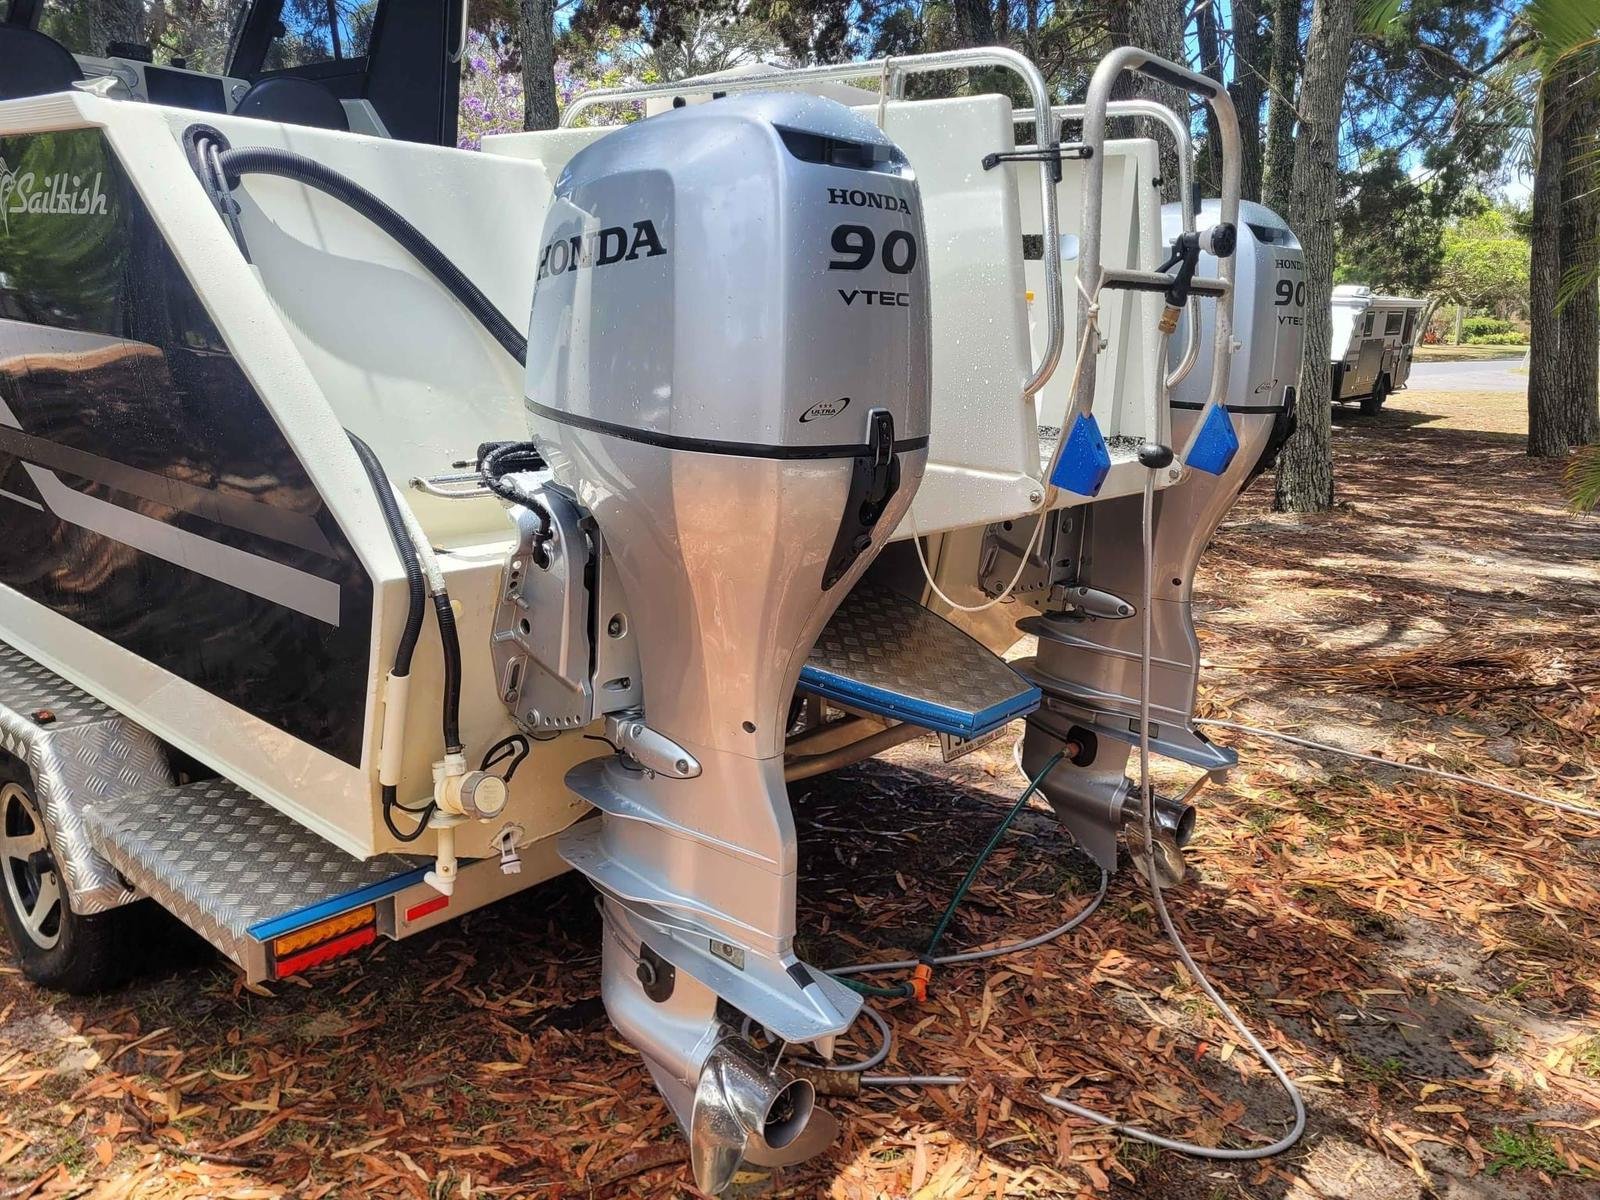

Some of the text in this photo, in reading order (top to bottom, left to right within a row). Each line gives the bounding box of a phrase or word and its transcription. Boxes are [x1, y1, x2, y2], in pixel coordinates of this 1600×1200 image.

[9, 172, 107, 214] Sailfish
[827, 187, 912, 216] HONDA
[537, 219, 667, 281] HONDA
[828, 224, 917, 274] 90
[838, 289, 910, 306] VTEC
[1274, 279, 1306, 307] 90
